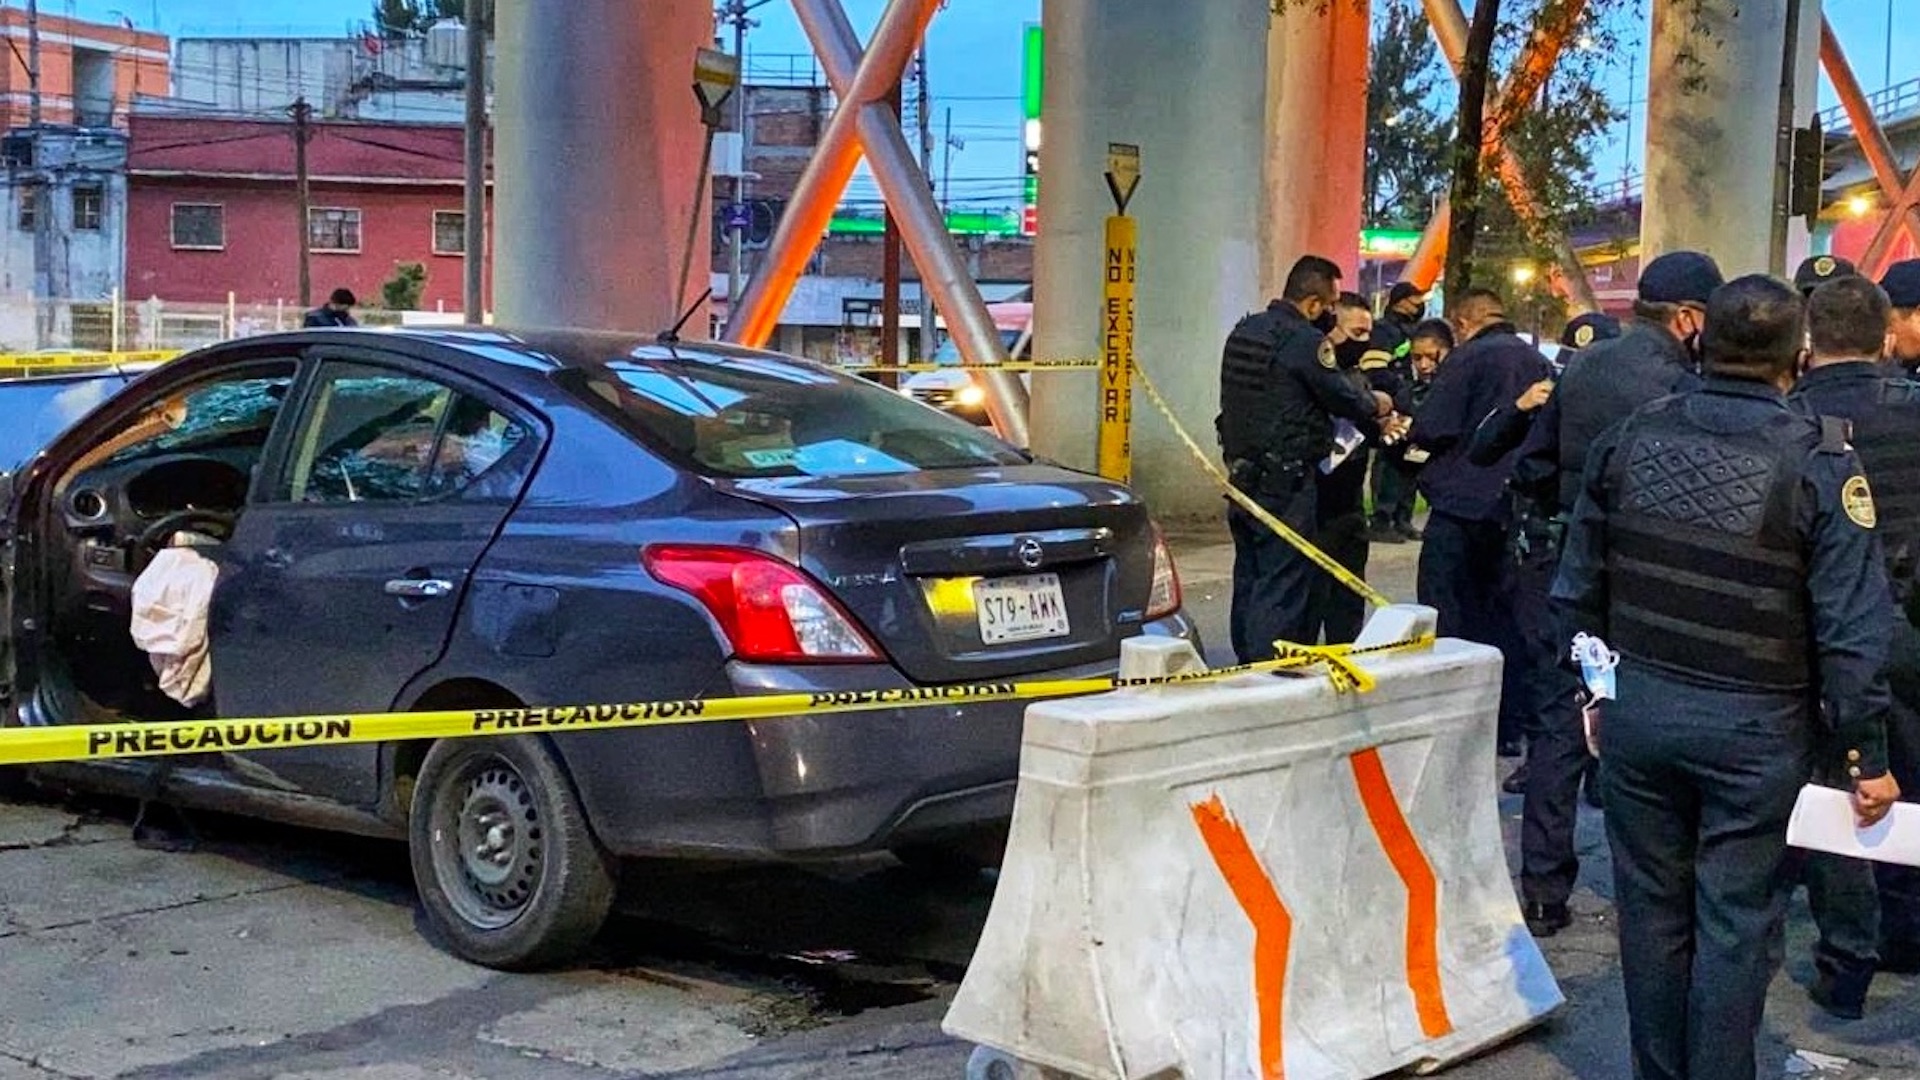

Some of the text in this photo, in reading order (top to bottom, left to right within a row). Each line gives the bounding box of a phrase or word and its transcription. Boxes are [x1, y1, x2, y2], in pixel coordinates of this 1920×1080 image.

[1105, 248, 1121, 422] NO EXCAVAR
[473, 700, 704, 730] PRECAUCION
[89, 720, 351, 754] PRECAUCION
